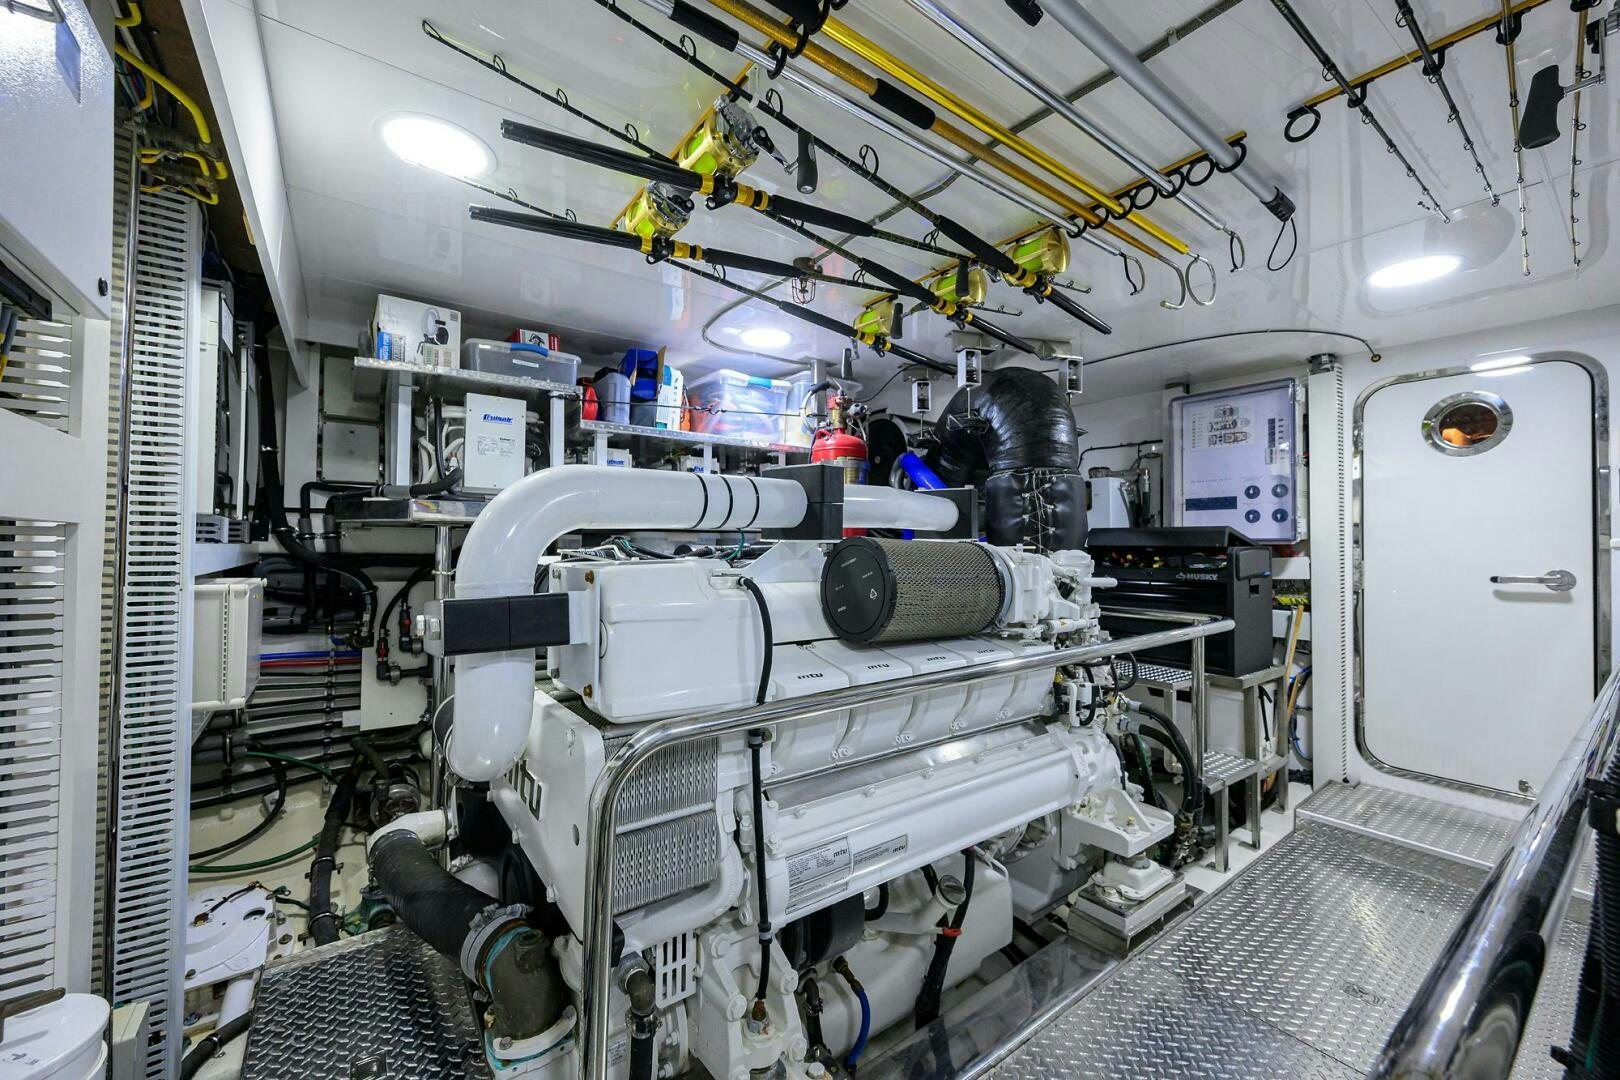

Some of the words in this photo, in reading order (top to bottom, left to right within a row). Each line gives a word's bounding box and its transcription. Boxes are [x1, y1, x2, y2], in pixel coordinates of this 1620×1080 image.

[483, 413, 513, 423] Cruisair
[1187, 573, 1218, 581] HUSKY
[797, 672, 824, 680] mtu
[833, 849, 847, 857] mtu
[893, 845, 905, 853] mtu
